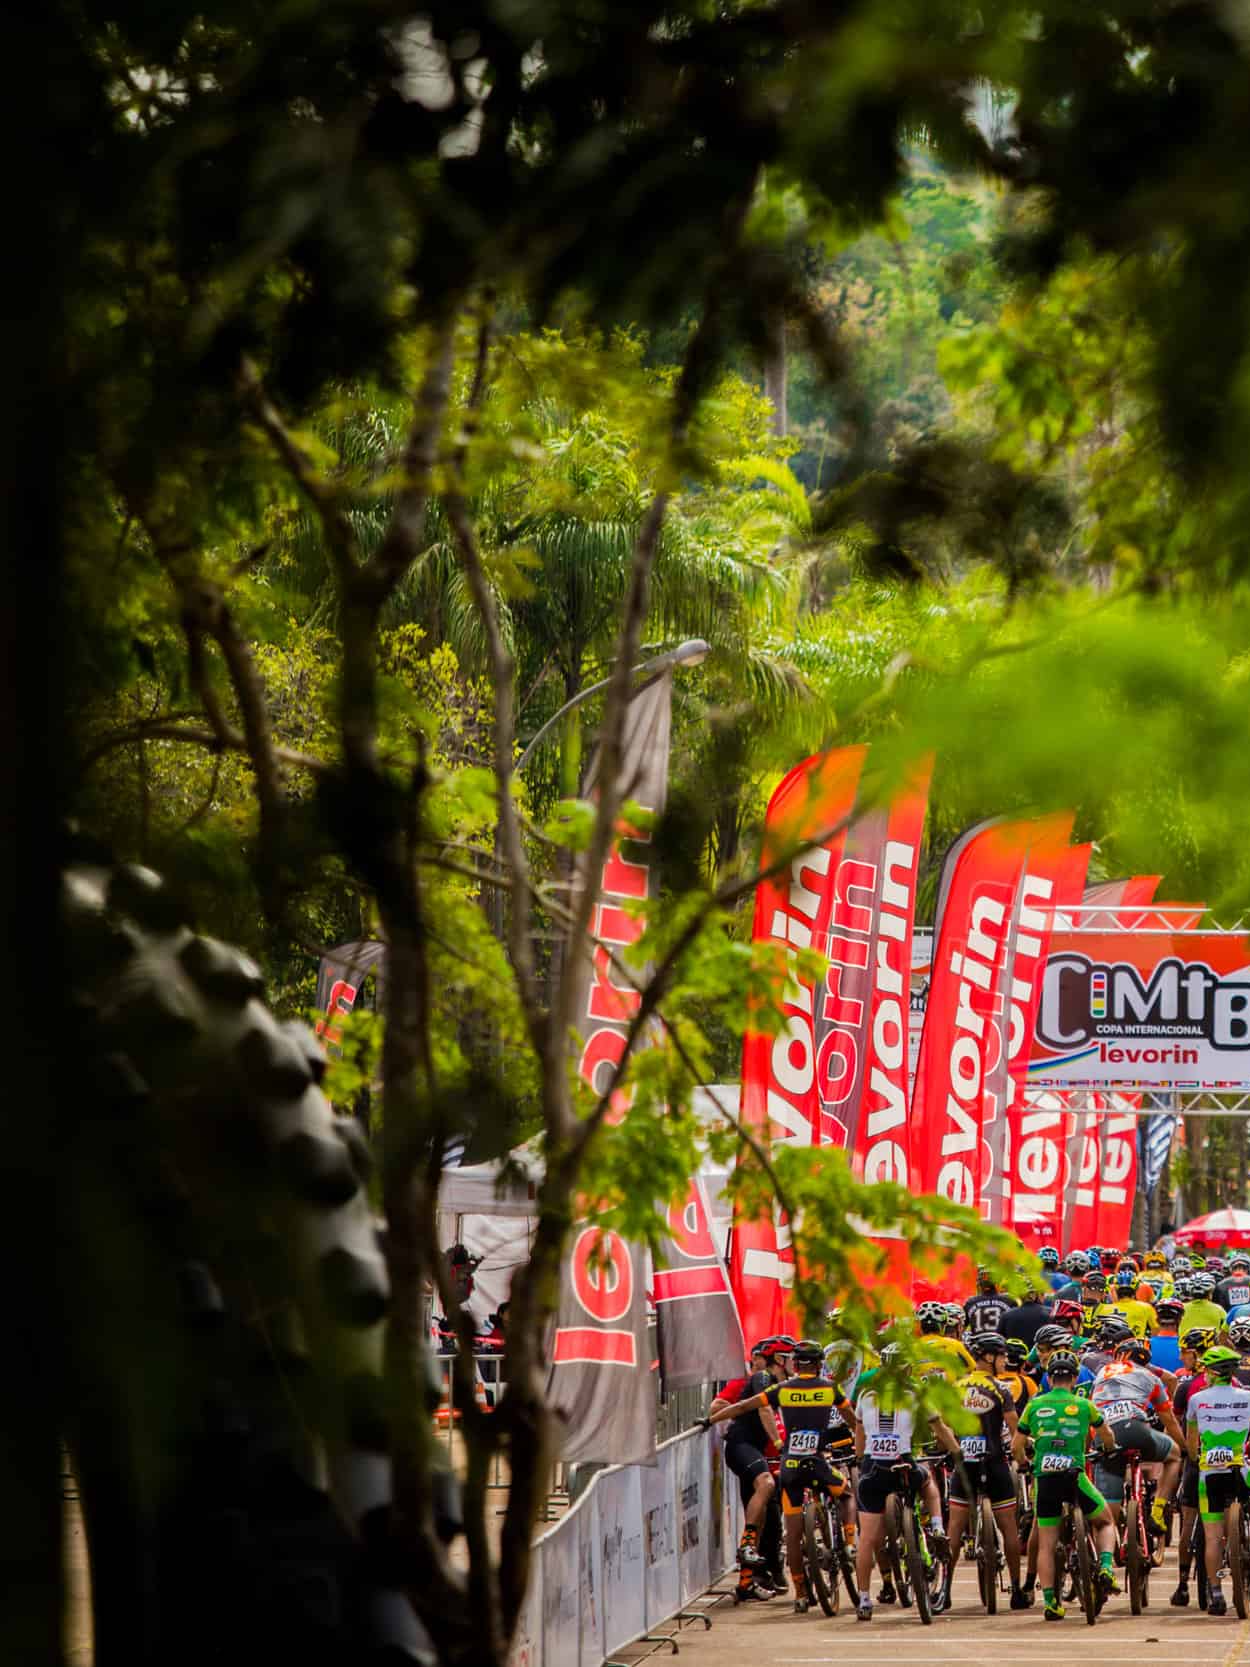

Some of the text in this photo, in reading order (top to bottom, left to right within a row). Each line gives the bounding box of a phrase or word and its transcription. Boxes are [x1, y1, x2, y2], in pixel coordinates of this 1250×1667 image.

[1096, 1024, 1203, 1035] COPA INTERNACIONAL
[936, 894, 1007, 1210] evorin
[1099, 1044, 1199, 1065] levorin
[552, 805, 657, 1368] leorin
[974, 1307, 1001, 1332] 13
[1106, 1402, 1131, 1417] 2421
[791, 1433, 817, 1448] 2418
[872, 1439, 898, 1452] 2425
[1043, 1456, 1069, 1470] 2424
